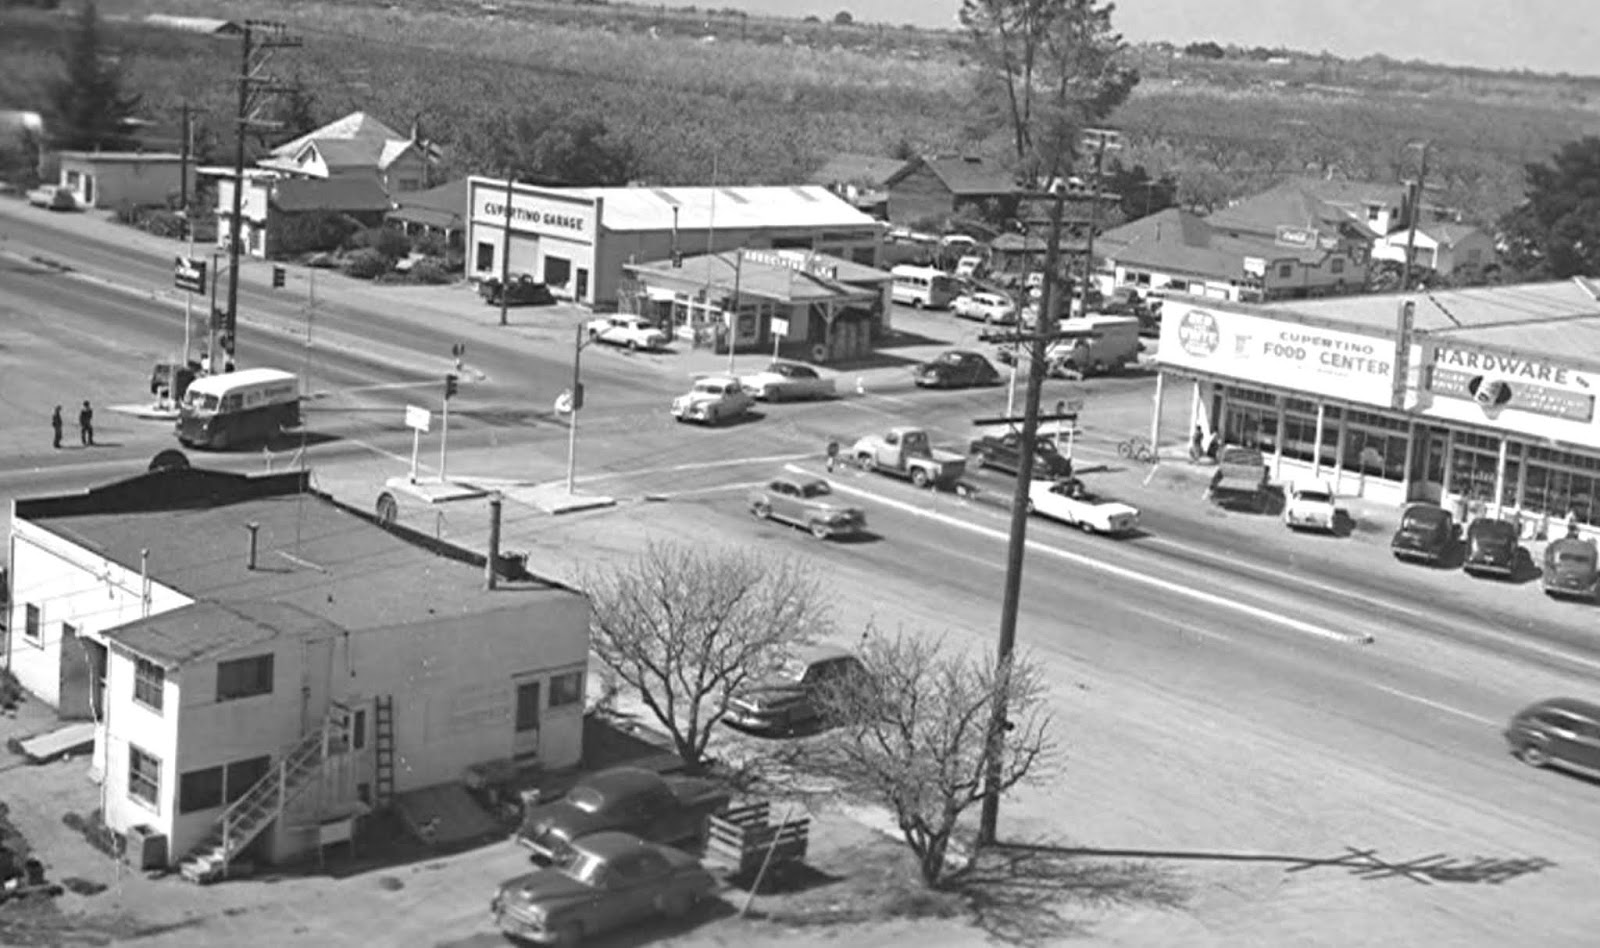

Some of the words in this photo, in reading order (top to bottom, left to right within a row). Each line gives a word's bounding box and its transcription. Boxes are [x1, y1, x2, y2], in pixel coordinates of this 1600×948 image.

[543, 213, 584, 231] GARAGE
[1279, 331, 1374, 355] CUPERTINO
[1263, 341, 1306, 361] FOOD
[1319, 351, 1390, 376] CENTER
[1434, 347, 1569, 385] HARDWARE
